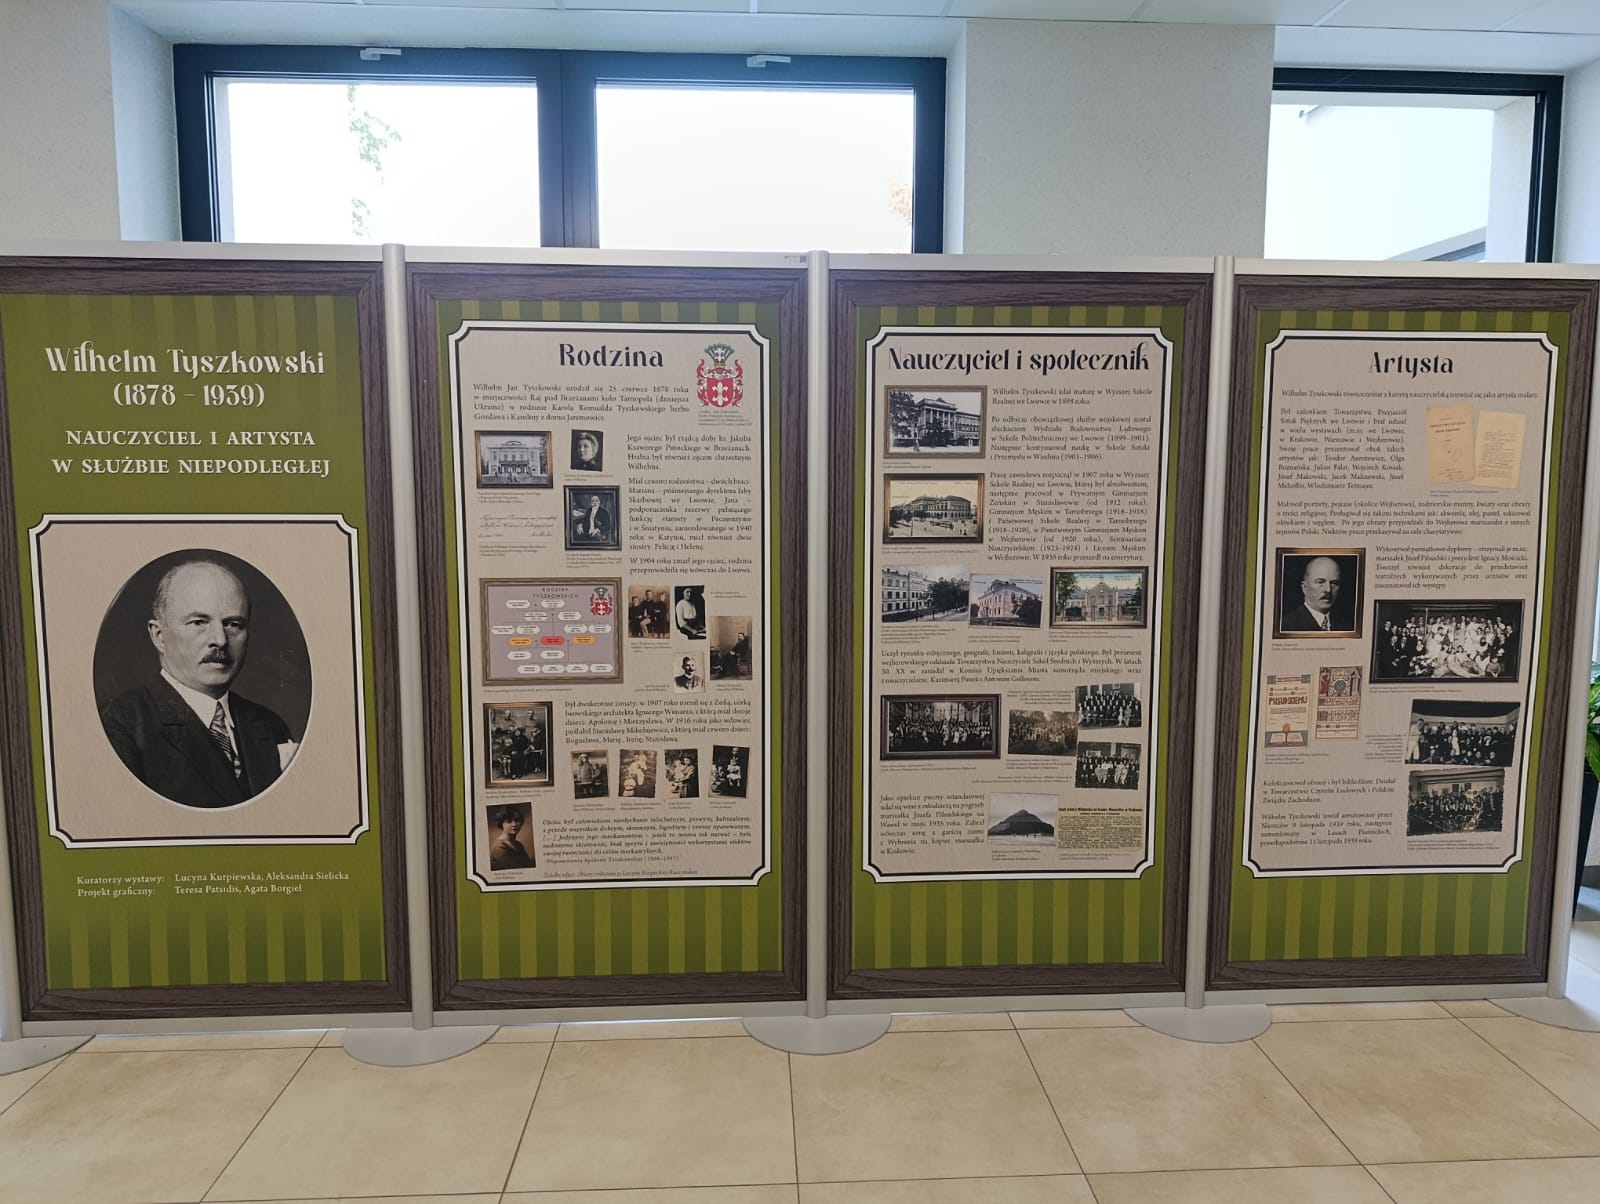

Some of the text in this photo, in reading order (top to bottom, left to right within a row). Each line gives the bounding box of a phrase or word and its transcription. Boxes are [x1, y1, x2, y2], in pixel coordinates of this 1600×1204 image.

[45, 341, 325, 379] Wilhelm Tyszkowski
[559, 344, 664, 368] Rodzina
[889, 347, 1009, 376] Nauczyciel
[1017, 350, 1023, 370] i
[1369, 352, 1453, 378] Artysta
[113, 383, 176, 406] (1878
[204, 384, 265, 408] 1939)
[65, 430, 316, 446] NAUCZYCIEL I ARTYSTA
[52, 456, 330, 478] W SŁUŻBIE NIEPODLEGŁEJ
[77, 876, 122, 885] Kuratorzy
[175, 873, 207, 883] Lucyna
[266, 872, 313, 881] Aleksandra
[316, 871, 349, 880] Sielicka
[78, 888, 110, 898] Projekt
[175, 886, 203, 894] Teresa
[244, 885, 269, 895] Agata
[271, 884, 302, 895] Borgiel
